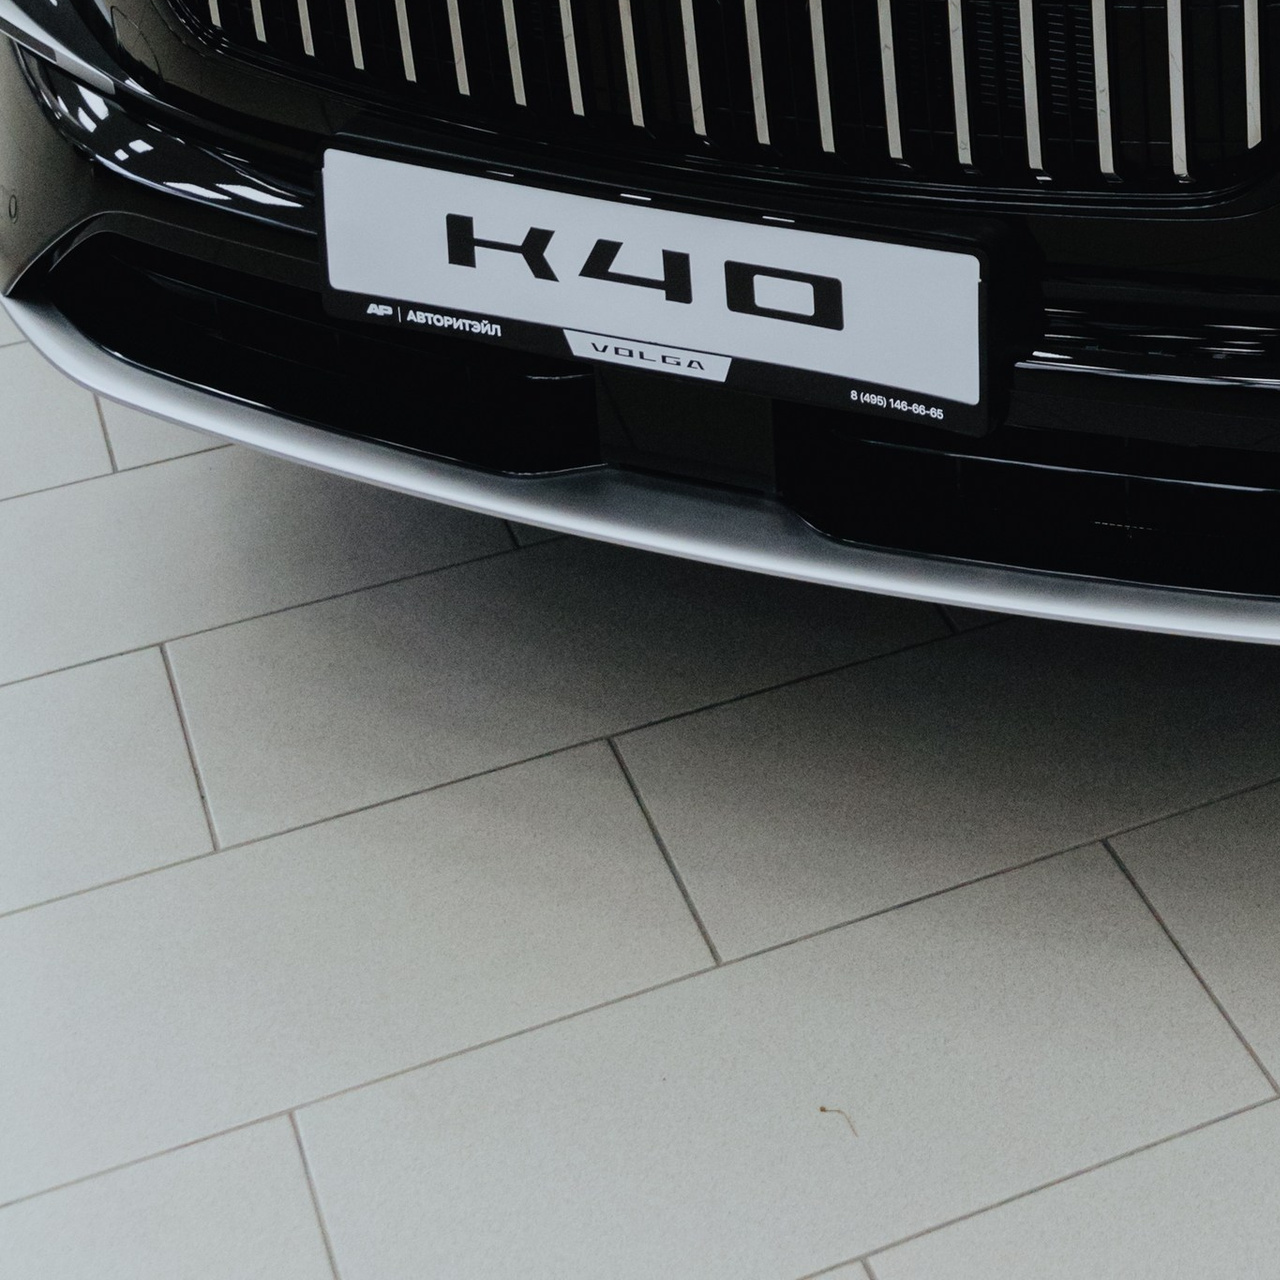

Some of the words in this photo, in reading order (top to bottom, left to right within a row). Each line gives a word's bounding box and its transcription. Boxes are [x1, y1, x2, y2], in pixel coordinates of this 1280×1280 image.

[445, 213, 844, 331] K40
[406, 309, 502, 337] АВТОРИТЭЙЛ
[591, 342, 705, 371] VOLGA
[850, 389, 858, 401] 8
[860, 392, 887, 408] (495)
[889, 398, 944, 420] 146-66-65
